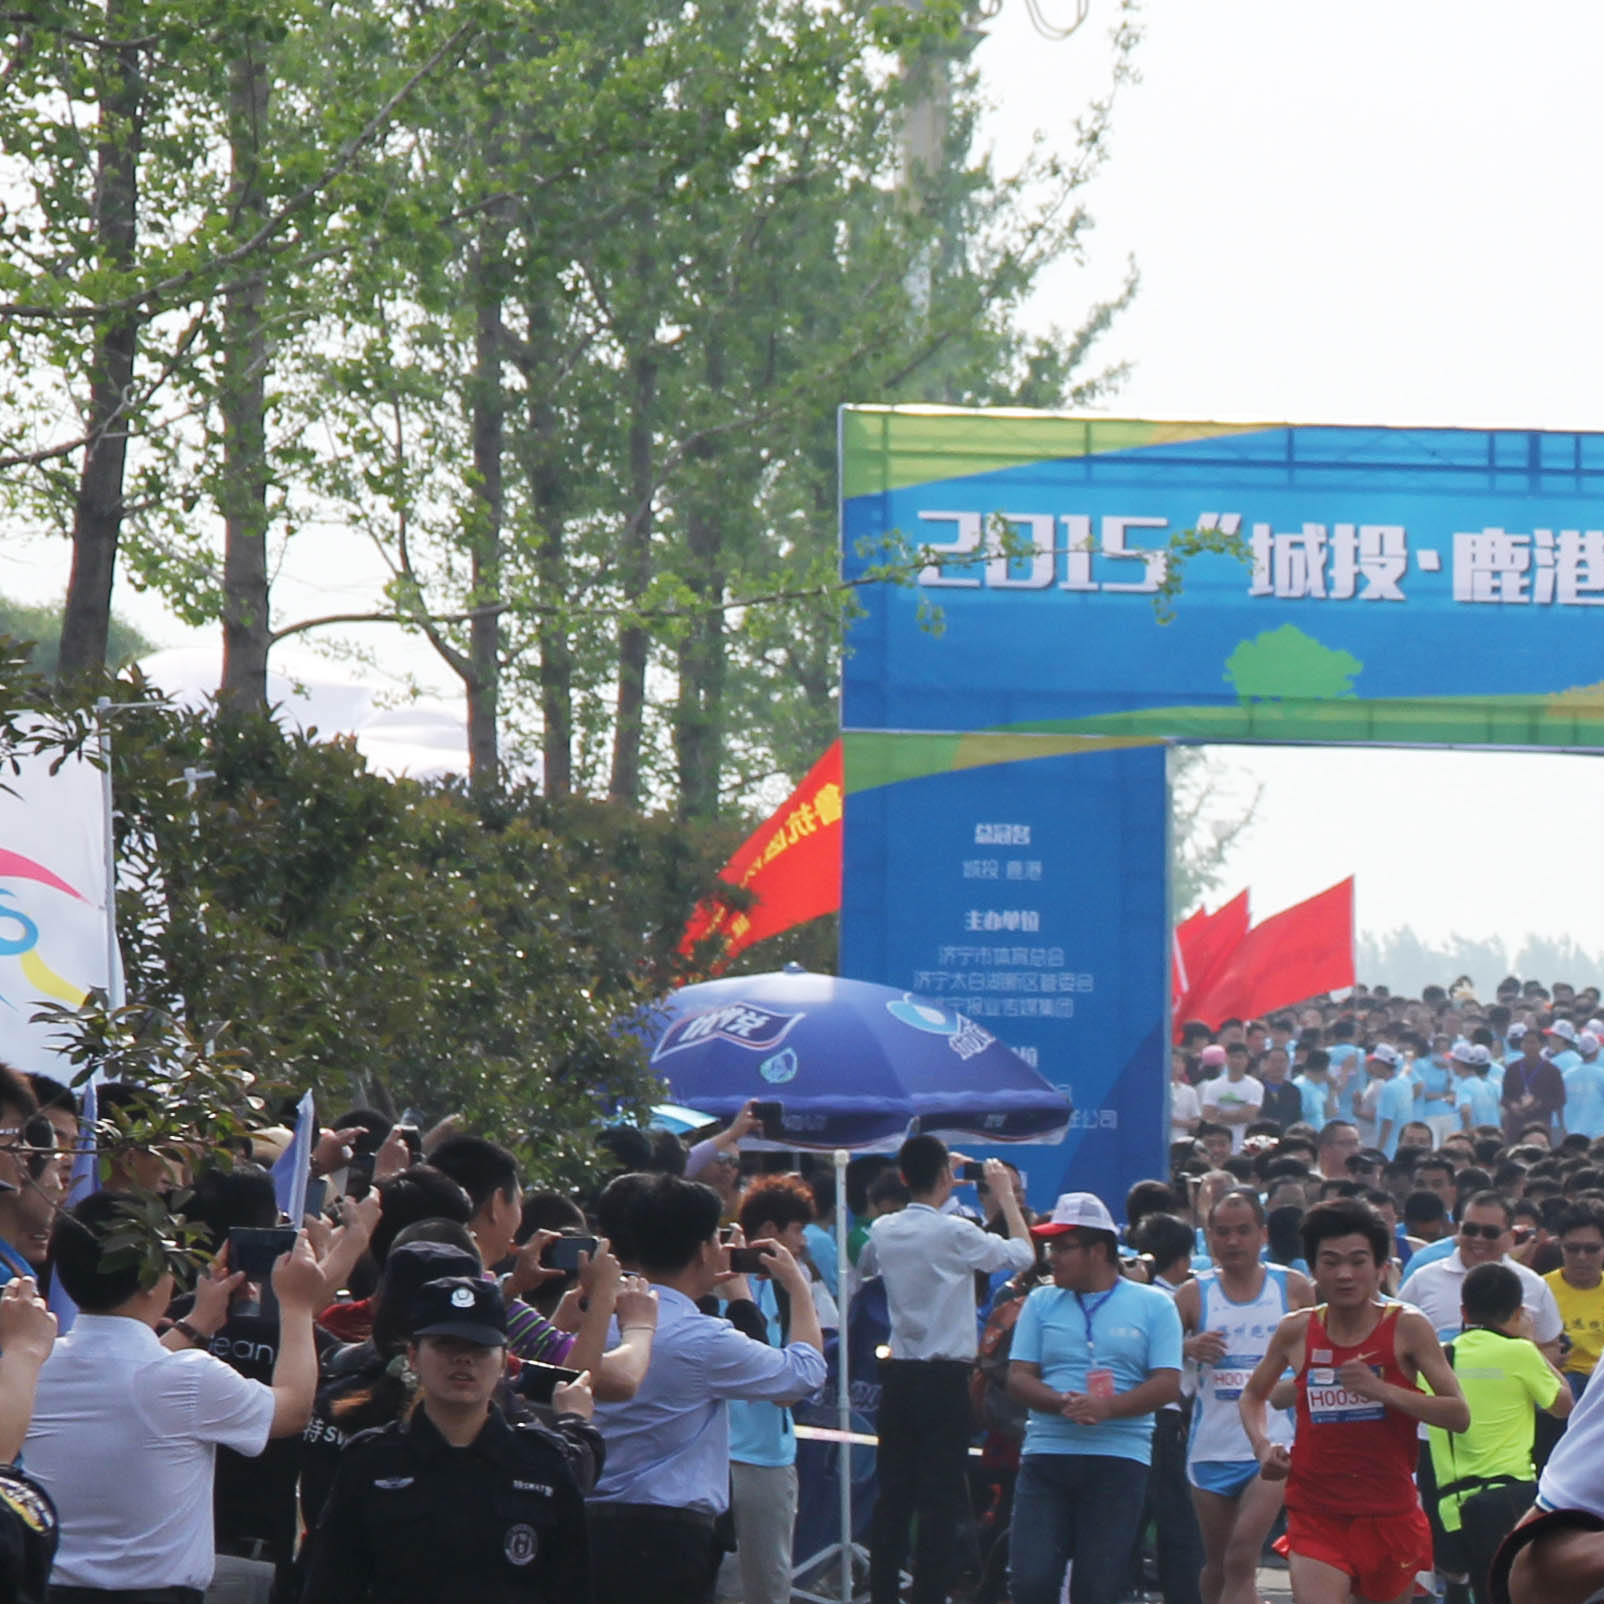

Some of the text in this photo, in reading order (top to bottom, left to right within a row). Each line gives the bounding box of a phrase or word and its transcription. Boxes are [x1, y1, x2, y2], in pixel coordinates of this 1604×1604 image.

[917, 510, 1168, 592] 2015
[965, 909, 1041, 932] 主办单位
